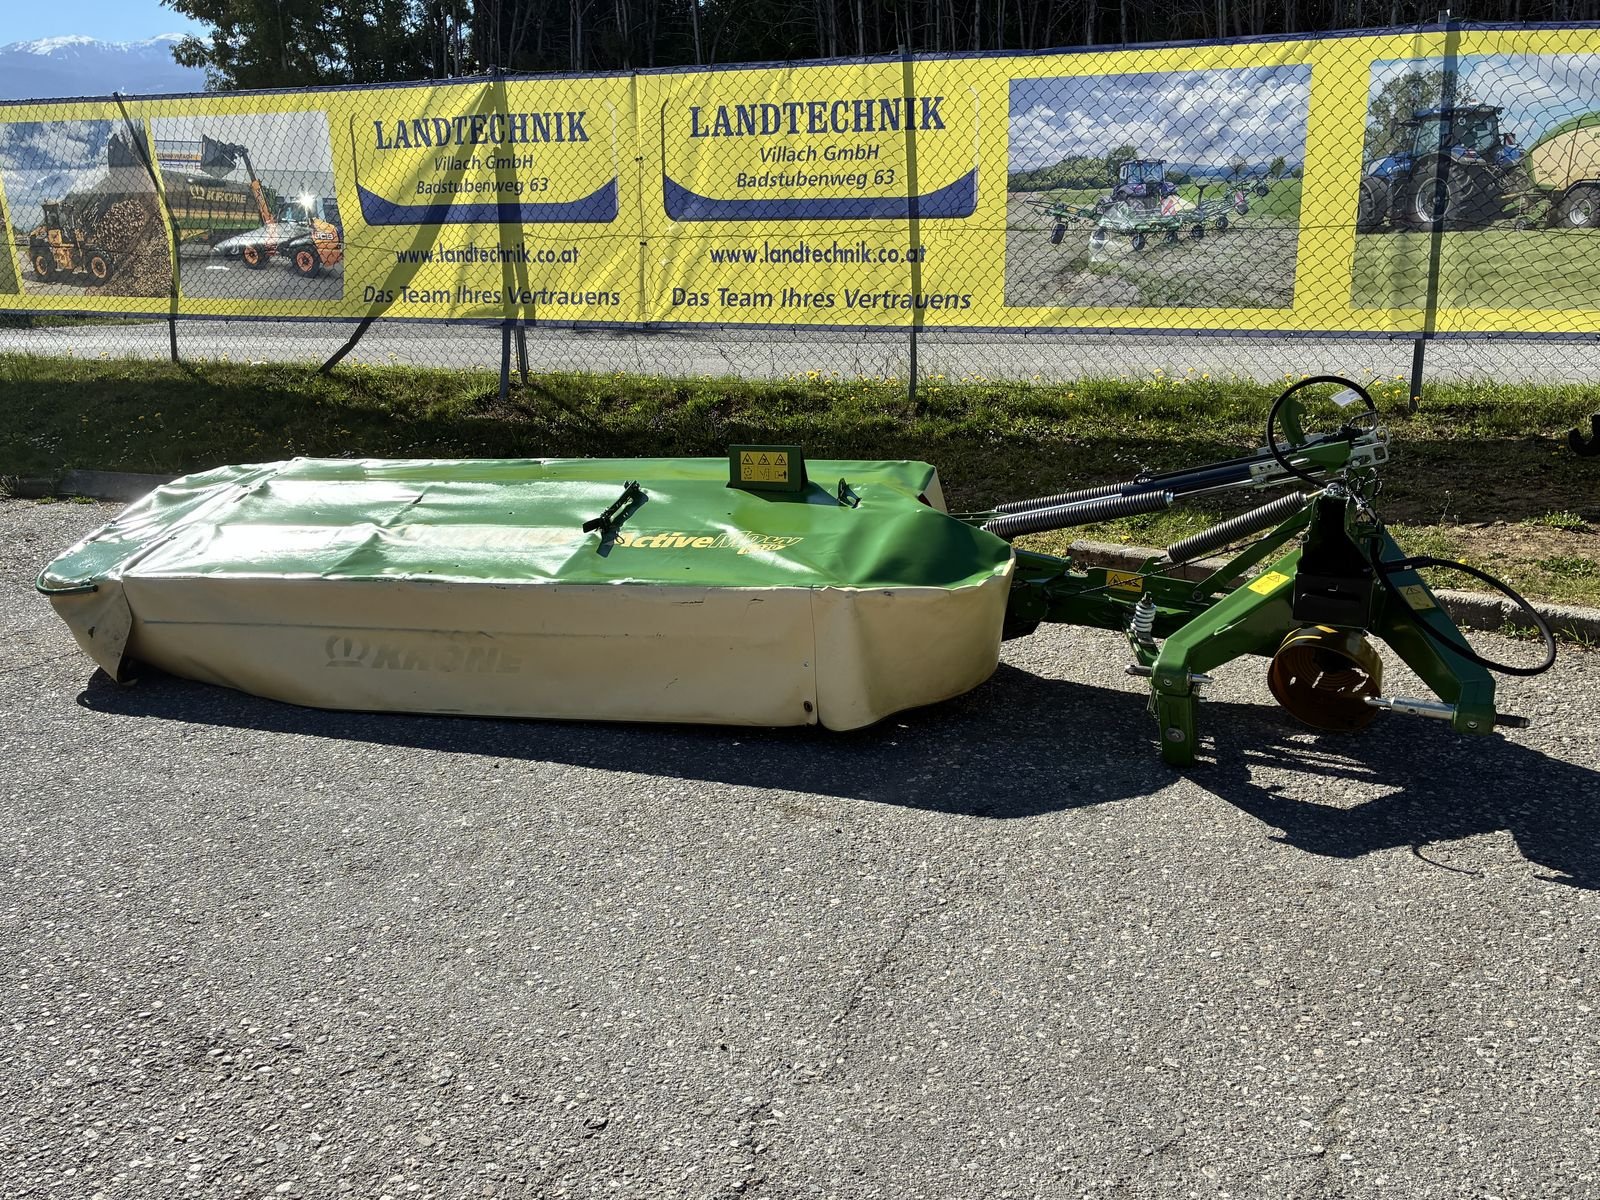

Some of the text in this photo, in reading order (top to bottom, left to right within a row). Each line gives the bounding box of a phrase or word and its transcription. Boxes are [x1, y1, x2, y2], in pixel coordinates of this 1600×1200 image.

[689, 95, 946, 138] LANDTECHNIK
[373, 110, 589, 150] LANDTECHNIK
[760, 144, 880, 162] Villach GmbH
[434, 155, 533, 172] Villach GmbH
[416, 177, 549, 195] Badstubenweg 63
[736, 169, 895, 189] Badstubenweg 63
[206, 190, 247, 203] KRONE
[396, 243, 579, 263] www.landtechnik.co.at
[709, 241, 926, 263] www.landtechnik.co.at
[364, 286, 620, 306] Das Team Ihres Vertrauens
[672, 288, 971, 310] Das Team Ihres Vertrauens
